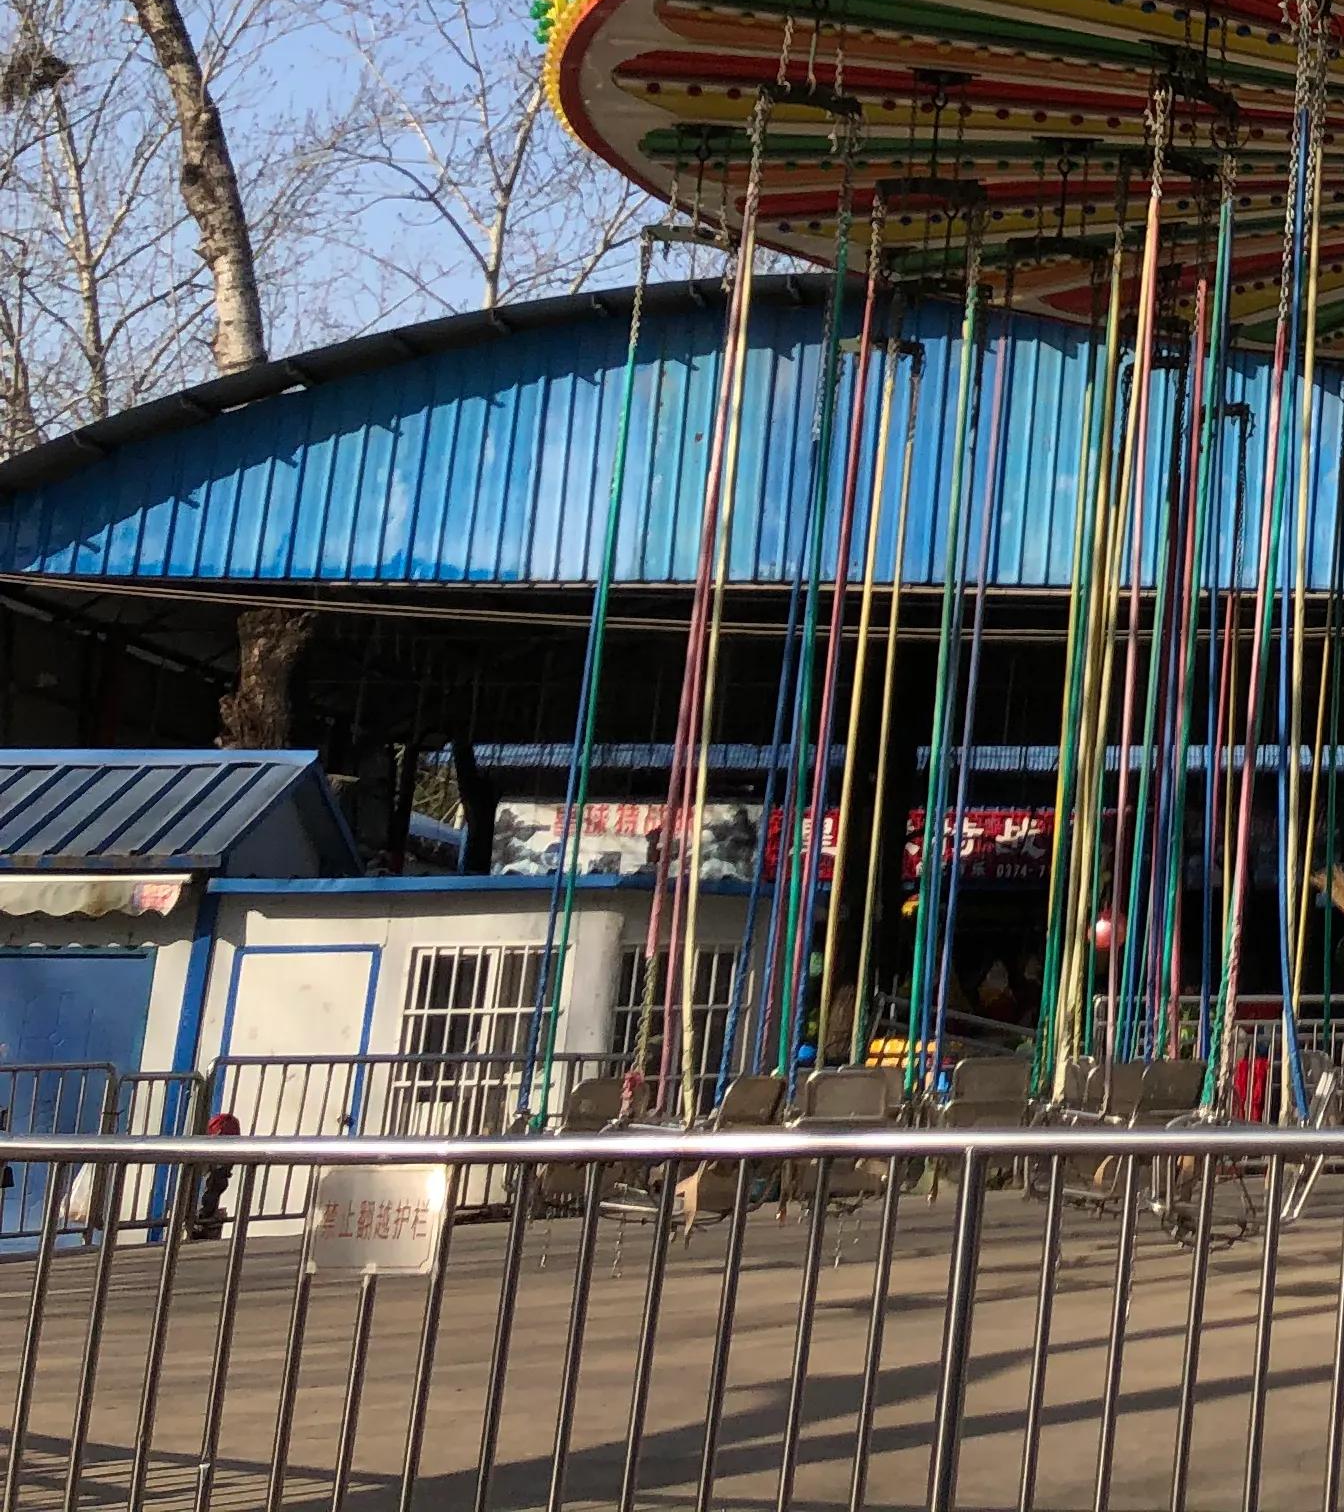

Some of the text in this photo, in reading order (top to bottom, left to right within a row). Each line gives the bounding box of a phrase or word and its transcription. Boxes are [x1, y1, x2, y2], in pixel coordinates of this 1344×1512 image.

[322, 1199, 431, 1240] 禁止翻越护栏
